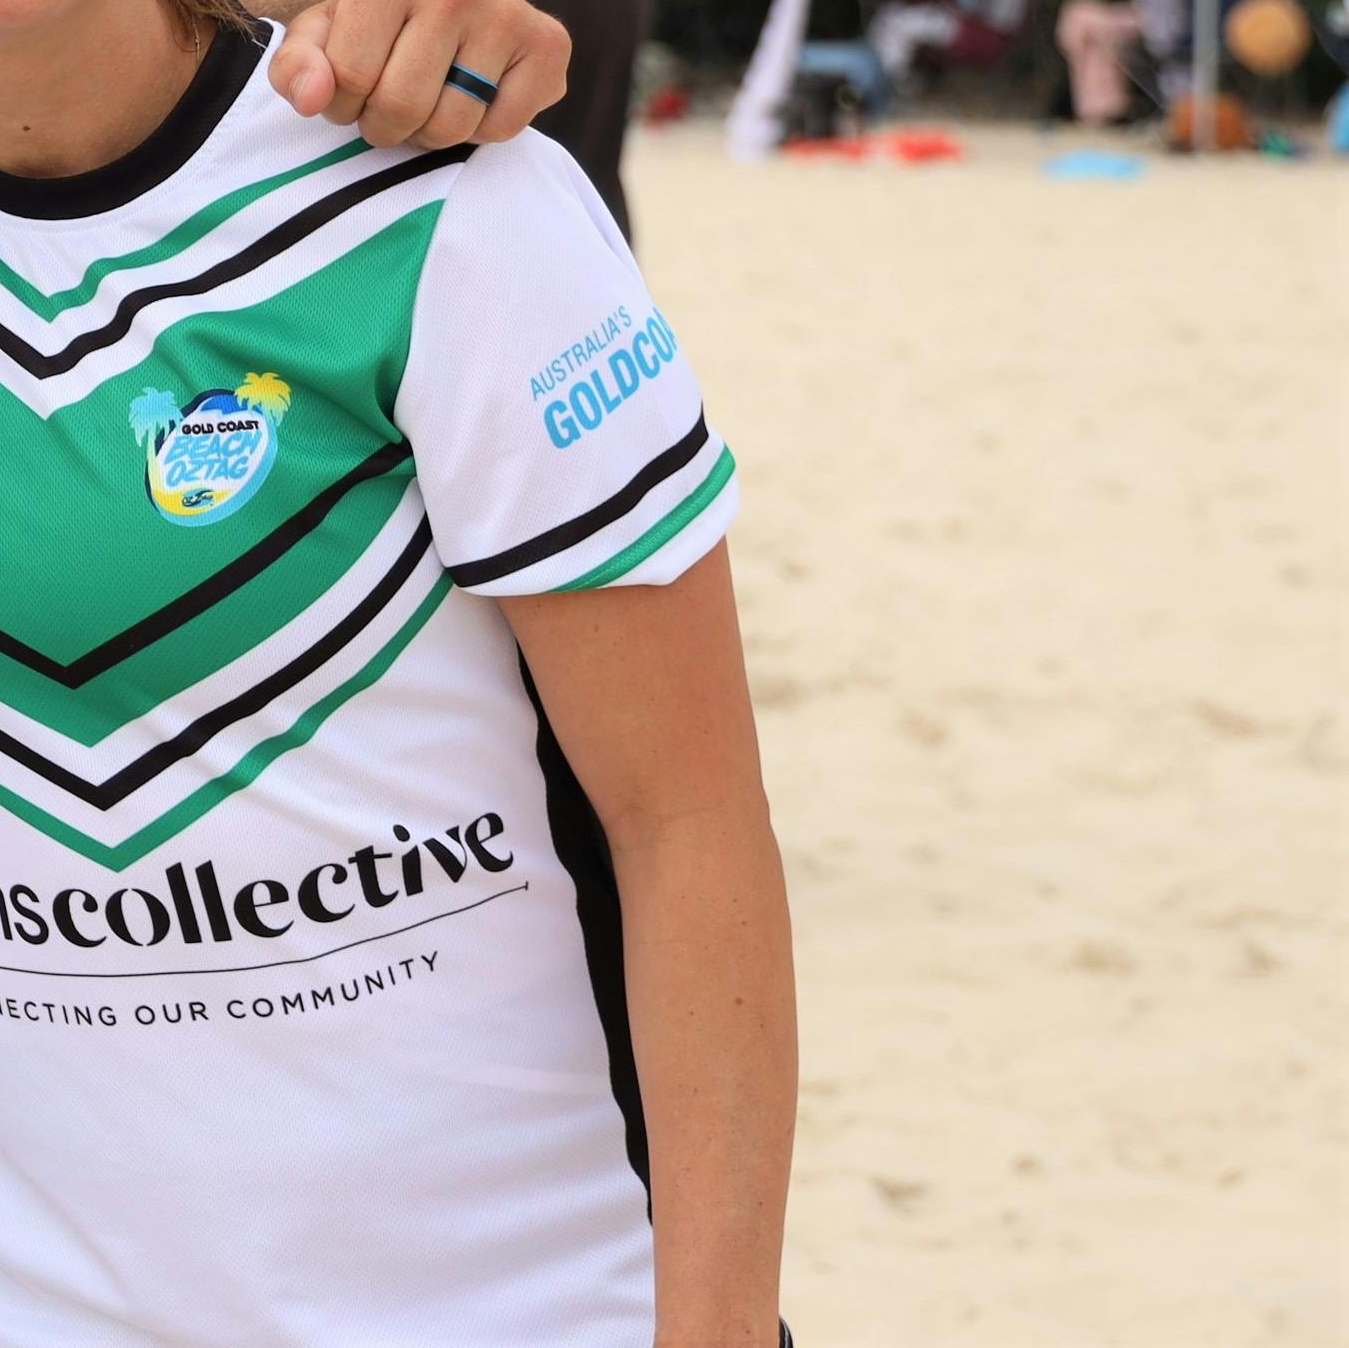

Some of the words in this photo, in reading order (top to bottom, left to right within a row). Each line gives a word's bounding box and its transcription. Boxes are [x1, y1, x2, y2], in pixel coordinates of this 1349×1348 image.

[530, 305, 632, 401] AUSTRALIA'S
[544, 307, 676, 449] GOLDCO
[182, 423, 213, 435] GOLD
[217, 420, 259, 433] COAST
[166, 456, 249, 487] OZTAG
[135, 1001, 209, 1026] OUR
[227, 950, 440, 1020] COMMUNITY
